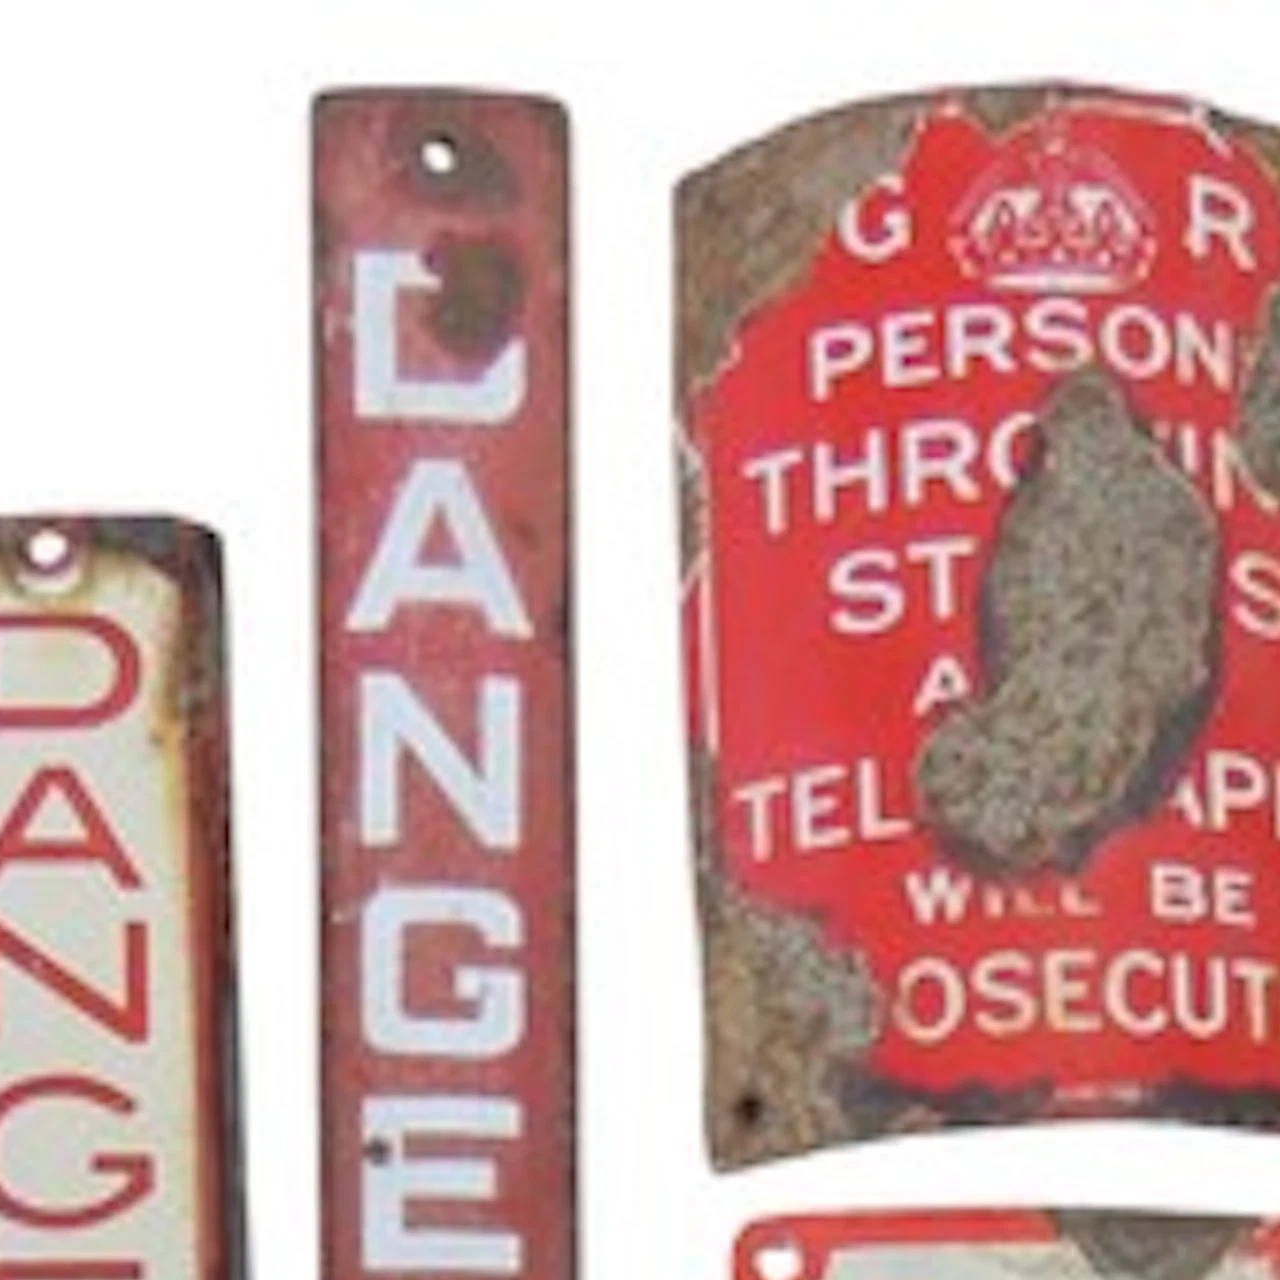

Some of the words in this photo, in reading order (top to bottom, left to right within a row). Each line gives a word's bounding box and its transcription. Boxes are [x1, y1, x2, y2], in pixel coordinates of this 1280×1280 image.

[836, 173, 911, 261] G
[1185, 174, 1257, 271] R
[808, 299, 1232, 400] PERSON
[1150, 862, 1256, 926] BE
